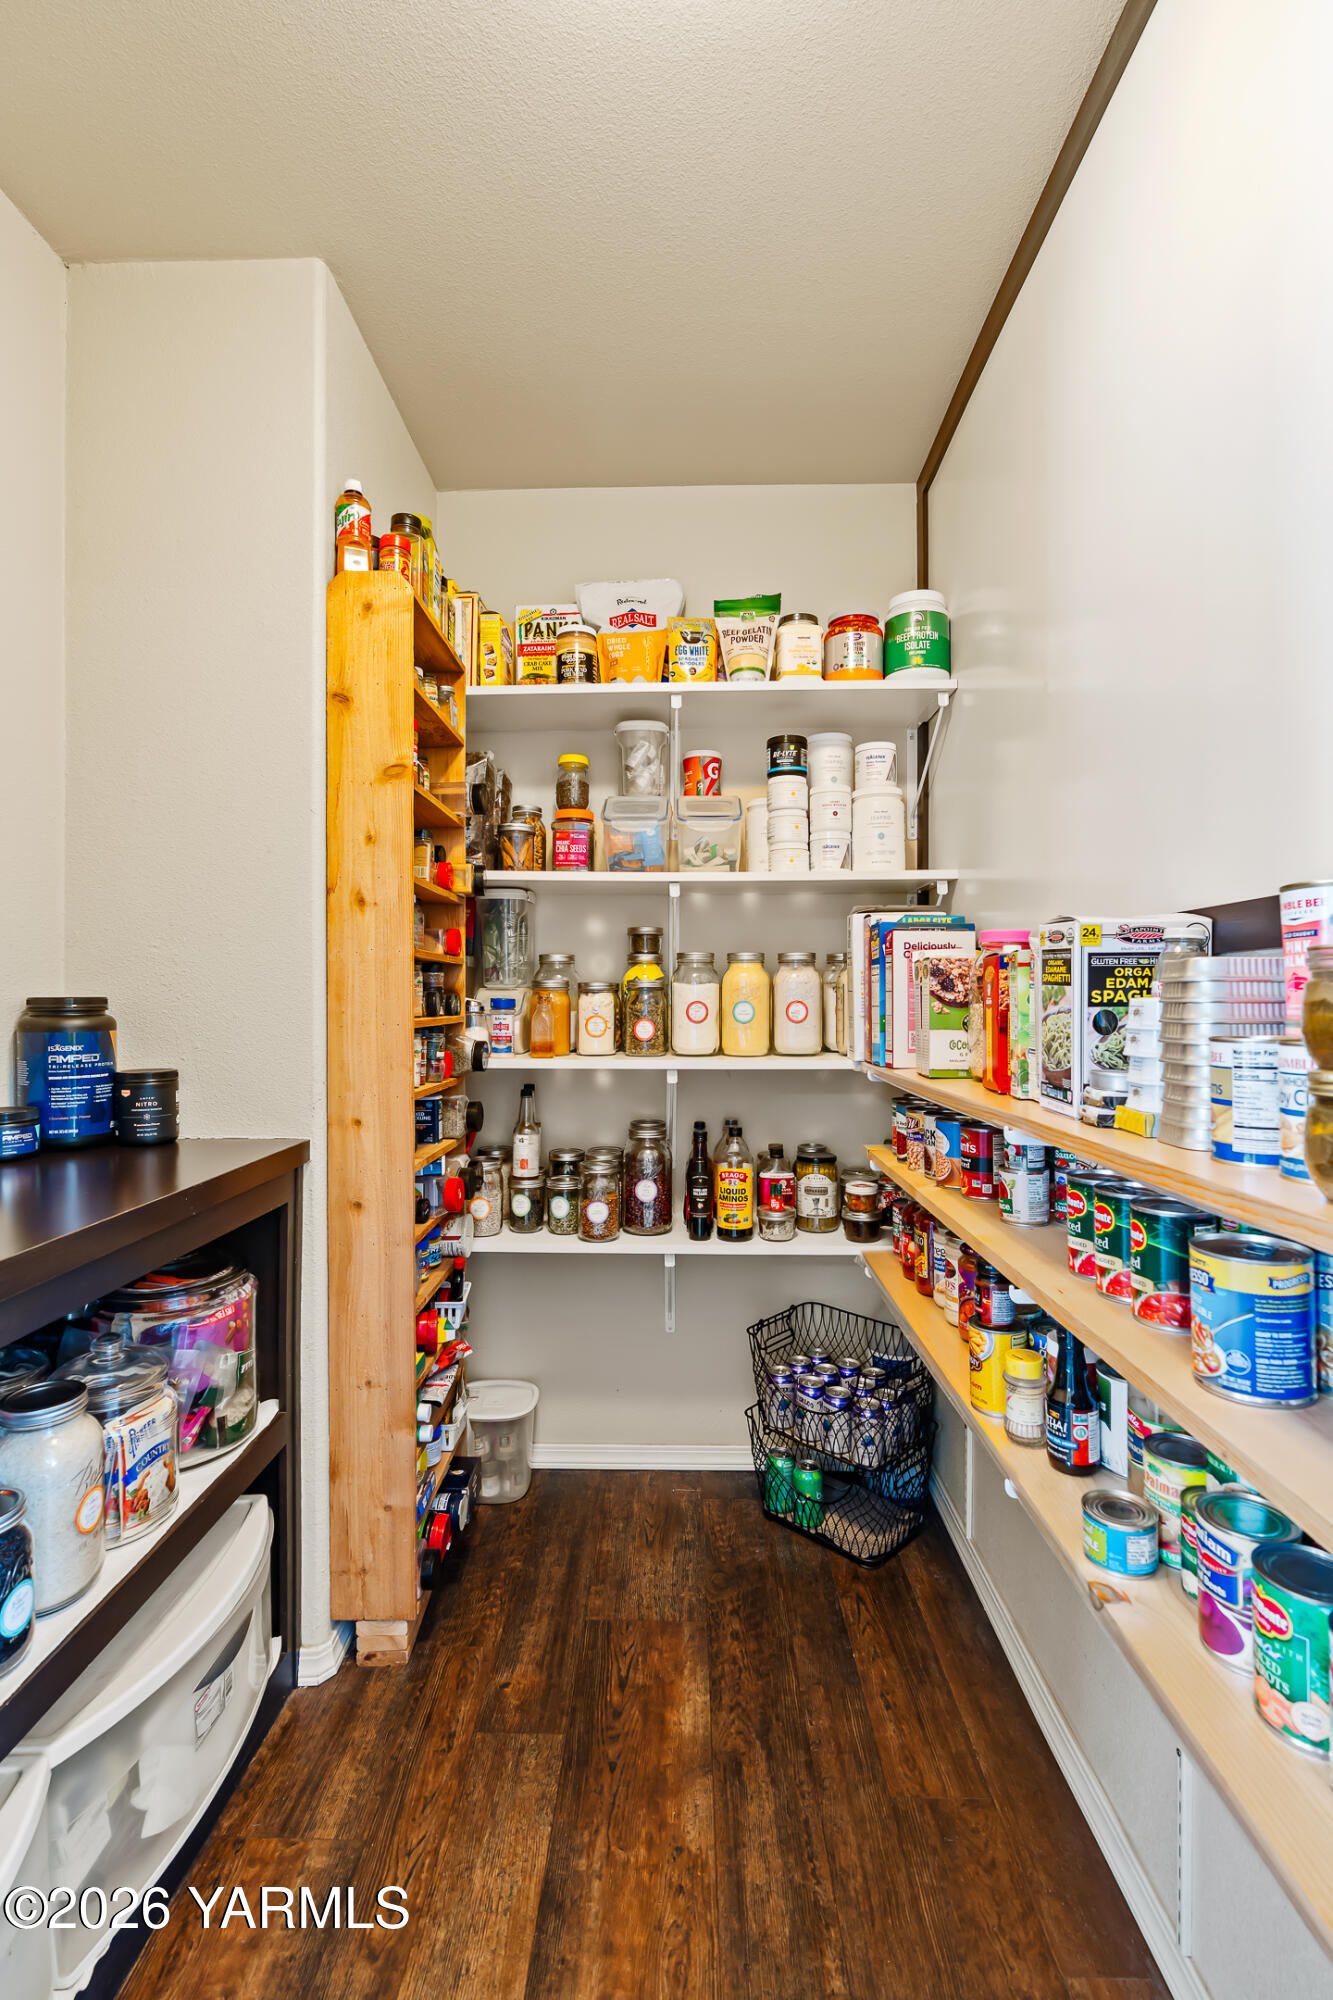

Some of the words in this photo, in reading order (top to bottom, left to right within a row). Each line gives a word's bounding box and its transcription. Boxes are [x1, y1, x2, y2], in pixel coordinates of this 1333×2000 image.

[612, 614, 633, 628] REAL
[633, 613, 654, 626] SALT
[741, 625, 772, 636] GELATIN
[730, 635, 764, 645] POWDER
[674, 645, 688, 656] EGG
[689, 645, 710, 656] WHITE
[707, 762, 719, 780] G
[555, 844, 569, 853] CHIA
[570, 844, 587, 853] SEEDS
[1082, 928, 1097, 938] 24
[903, 942, 957, 951] Deliciously
[1091, 957, 1119, 966] GLUTEN
[1119, 957, 1138, 966] FREE
[1114, 967, 1155, 977] ORGA
[1042, 973, 1071, 983] SPAGHETTI
[1106, 978, 1153, 989] EDAM
[48, 1053, 100, 1063] AMPED
[719, 1187, 747, 1195] LIQUID
[719, 1194, 749, 1203] AMINOS
